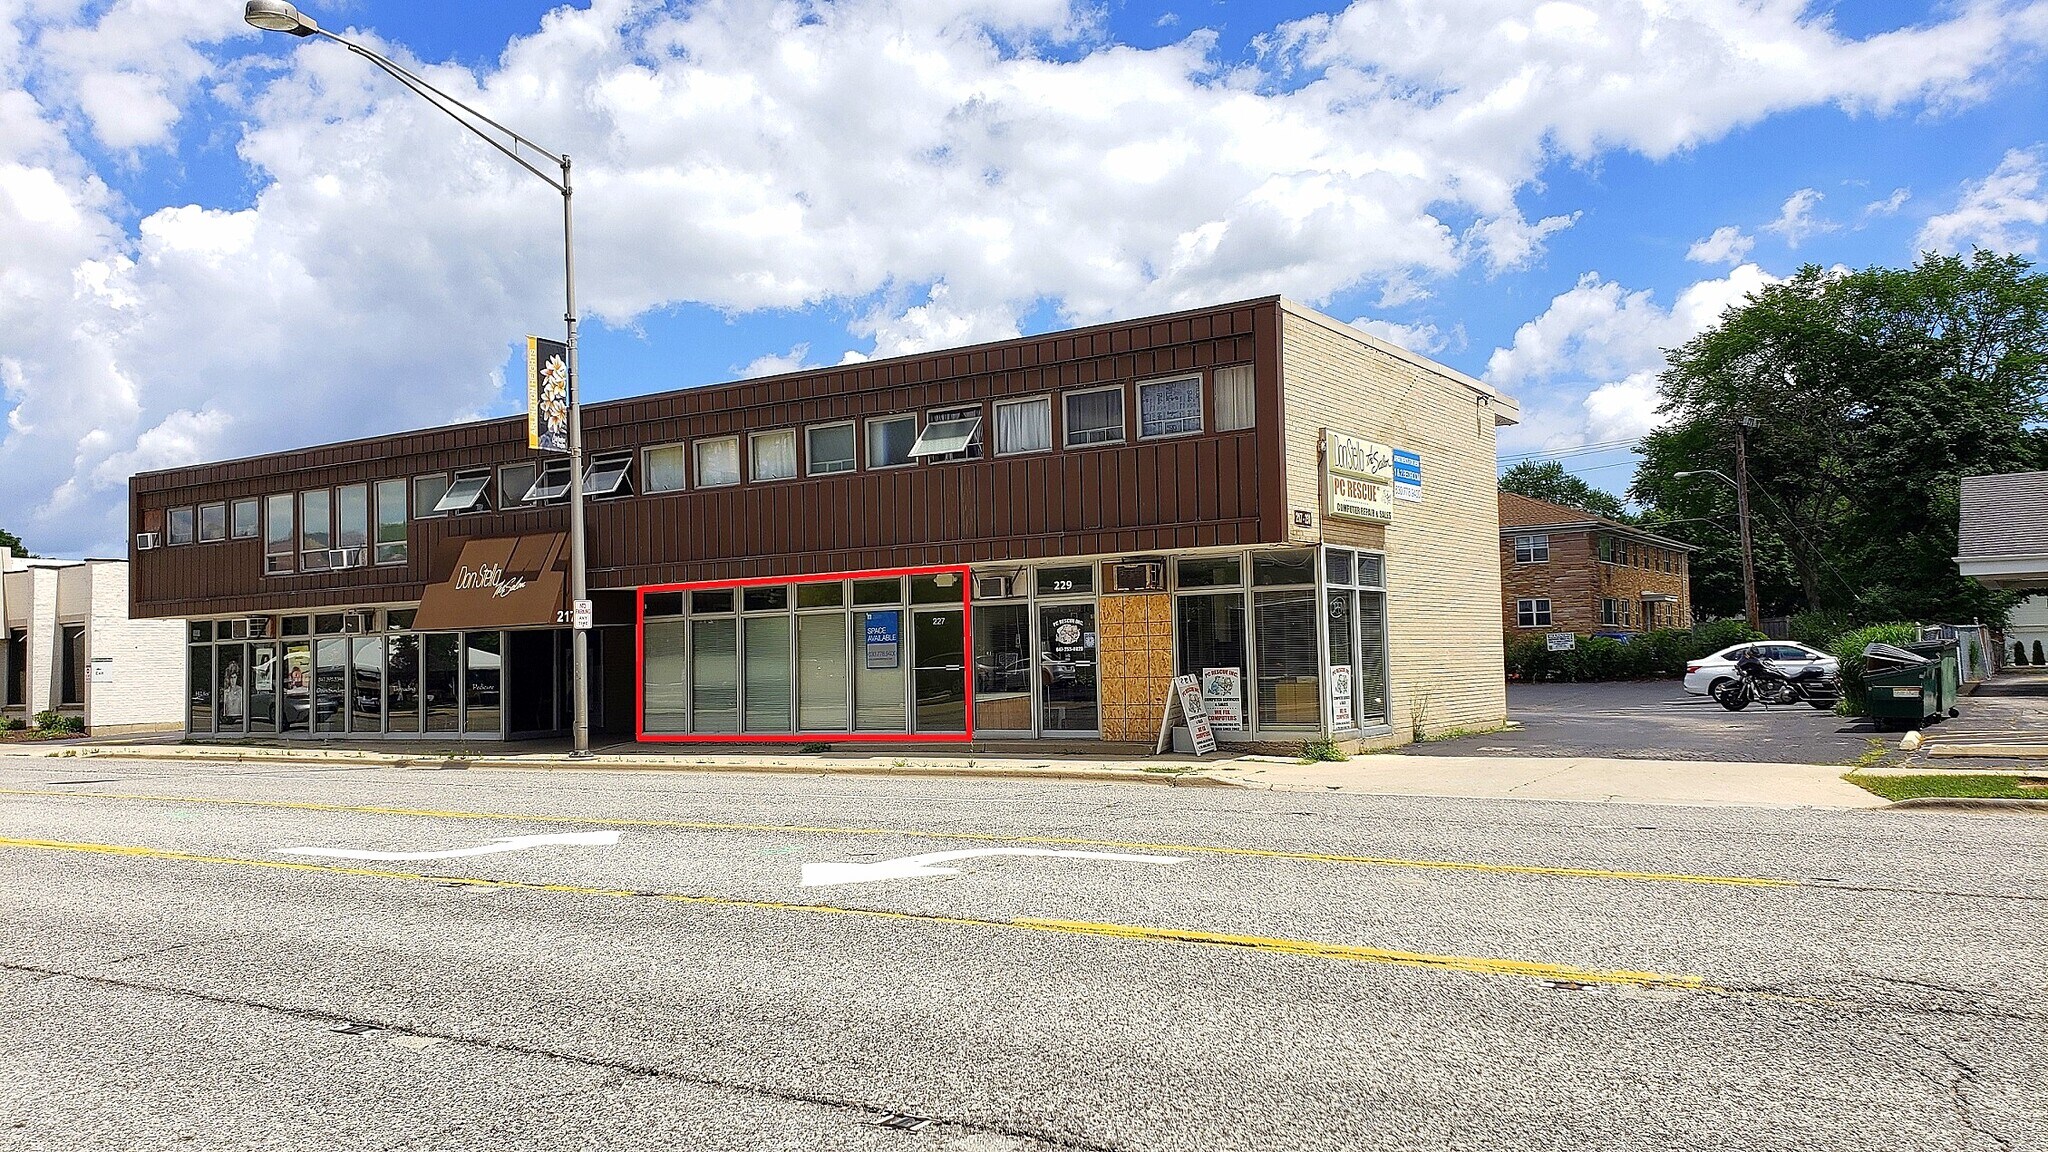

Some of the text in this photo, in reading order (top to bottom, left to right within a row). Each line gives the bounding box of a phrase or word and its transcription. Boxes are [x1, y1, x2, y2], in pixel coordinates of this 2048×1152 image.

[1334, 477, 1346, 497] PC
[1347, 479, 1377, 502] RESCUE
[1337, 502, 1360, 515] COMPUTER
[1360, 506, 1375, 518] REPAIR
[1379, 510, 1392, 520] SALES
[455, 565, 478, 590] Don
[475, 563, 503, 588] Stella
[1053, 580, 1073, 591] 229
[557, 610, 574, 623] 217
[932, 617, 945, 625] 227
[1053, 620, 1060, 628] PC
[867, 627, 886, 635] SPACE
[867, 633, 897, 642] AVAILABLE
